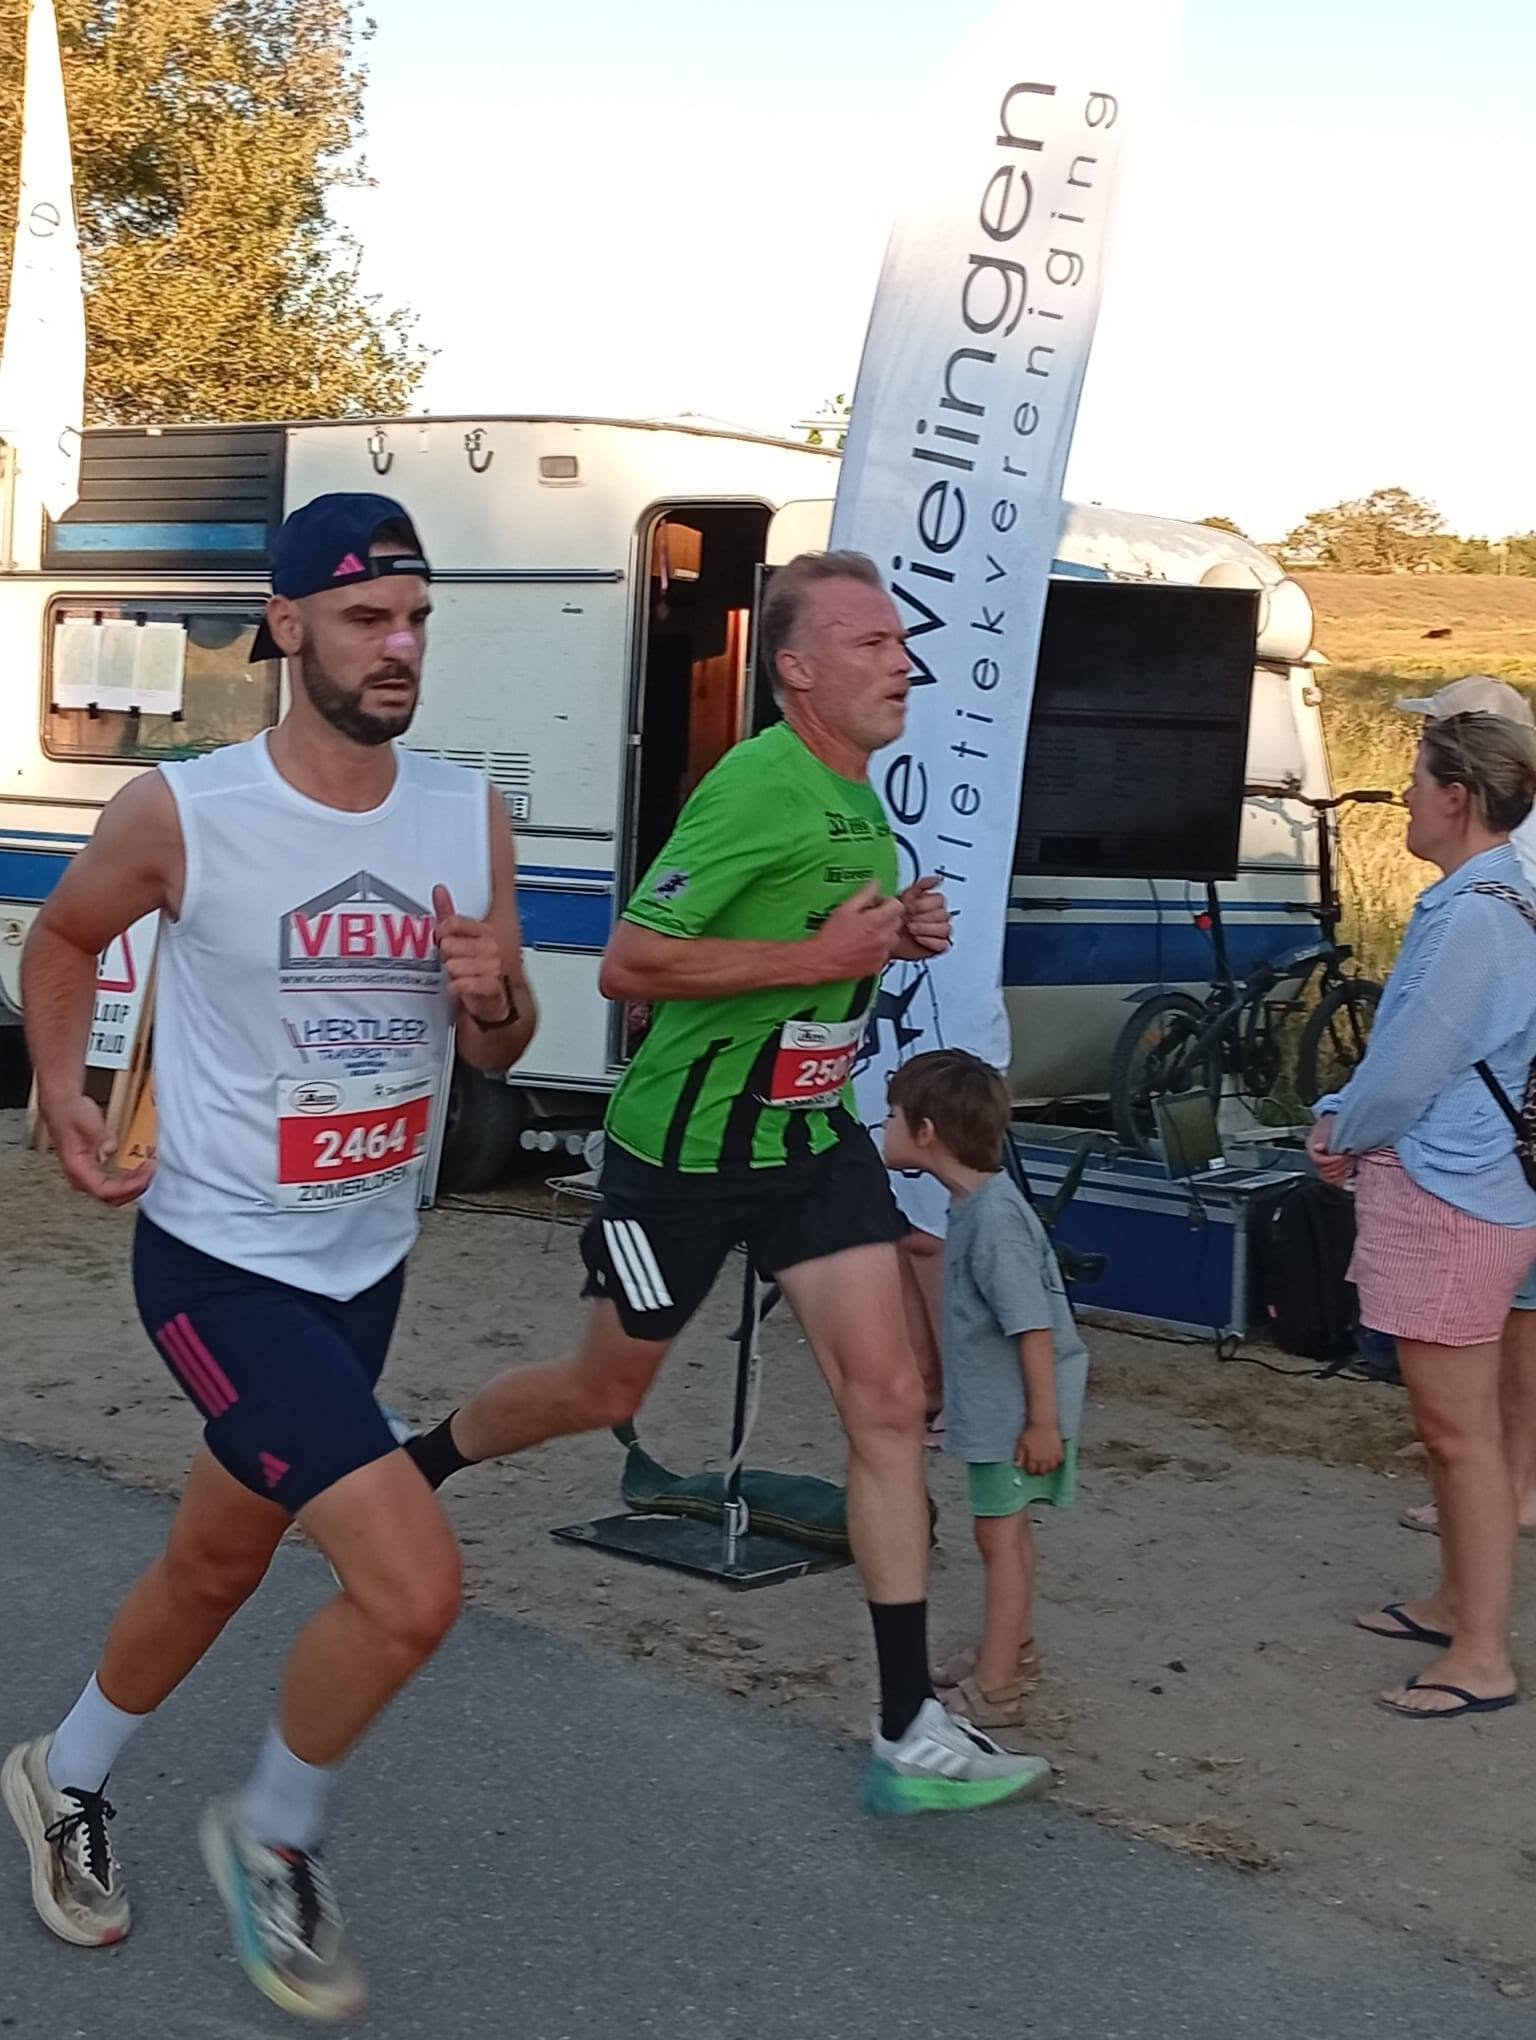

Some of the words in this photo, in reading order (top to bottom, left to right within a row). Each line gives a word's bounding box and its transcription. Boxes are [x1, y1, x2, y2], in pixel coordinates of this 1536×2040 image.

[934, 91, 1118, 946] tletiekvereniging
[294, 912, 432, 958] VBW
[313, 1117, 408, 1169] 2464
